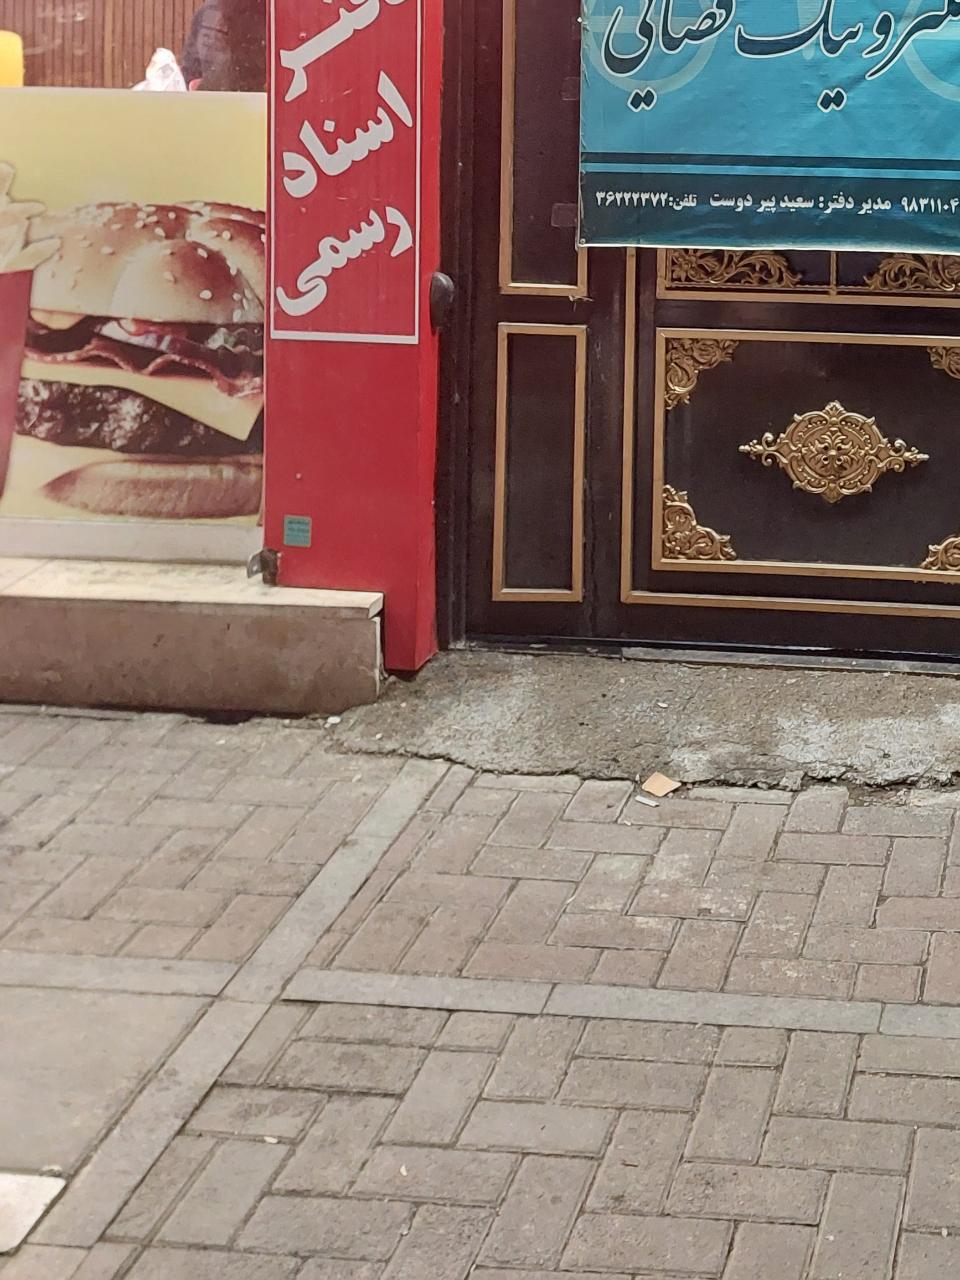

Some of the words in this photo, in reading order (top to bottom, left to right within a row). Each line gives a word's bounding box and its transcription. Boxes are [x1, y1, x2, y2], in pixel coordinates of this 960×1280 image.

[282, 69, 413, 199] اسناد
[709, 192, 753, 212] دوست
[756, 195, 776, 213] پیر
[779, 194, 814, 212] سعید
[857, 196, 892, 215] مدیر
[275, 205, 413, 317] رسمی
